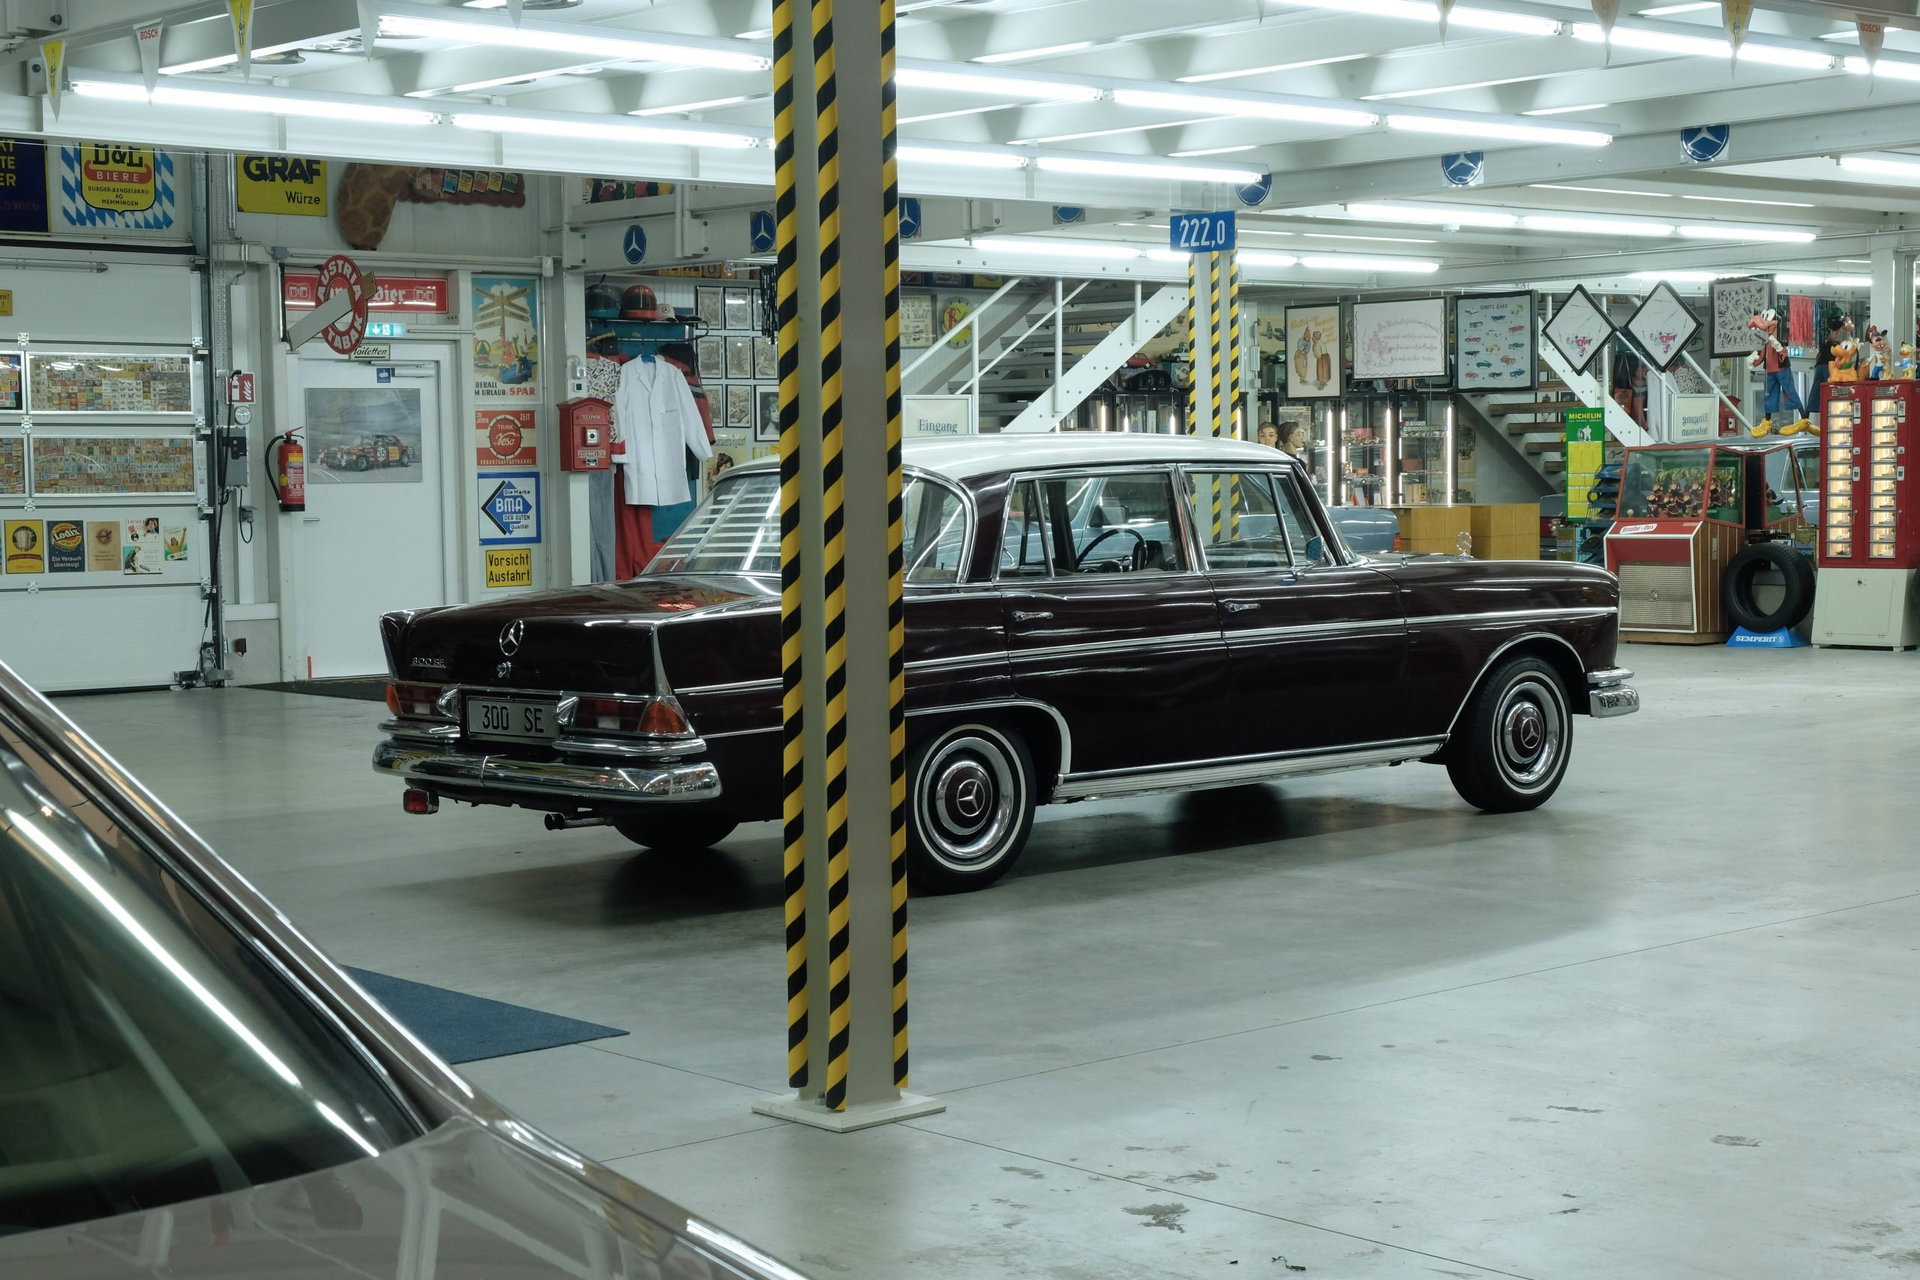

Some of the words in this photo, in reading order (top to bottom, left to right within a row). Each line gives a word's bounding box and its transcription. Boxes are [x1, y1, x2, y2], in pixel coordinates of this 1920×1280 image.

[140, 28, 158, 40] BOSCH
[1860, 22, 1880, 33] BOSCH
[96, 171, 140, 182] BIERE
[243, 156, 321, 184] GRAF
[285, 190, 321, 204] Würze
[1179, 217, 1225, 248] 222,0
[327, 314, 364, 350] TABAK
[353, 345, 387, 355] Toiletten
[475, 381, 497, 389] BERALL
[509, 387, 536, 396] SPAR
[520, 413, 530, 421] ZEIT
[918, 419, 958, 434] Eingang
[376, 449, 387, 458] 35
[495, 498, 523, 513] BMA
[53, 528, 81, 541] Lodix
[488, 553, 529, 567] Vorsicht
[488, 568, 530, 583] Ausfahrt
[481, 704, 509, 731] 300
[524, 706, 544, 733] SE
